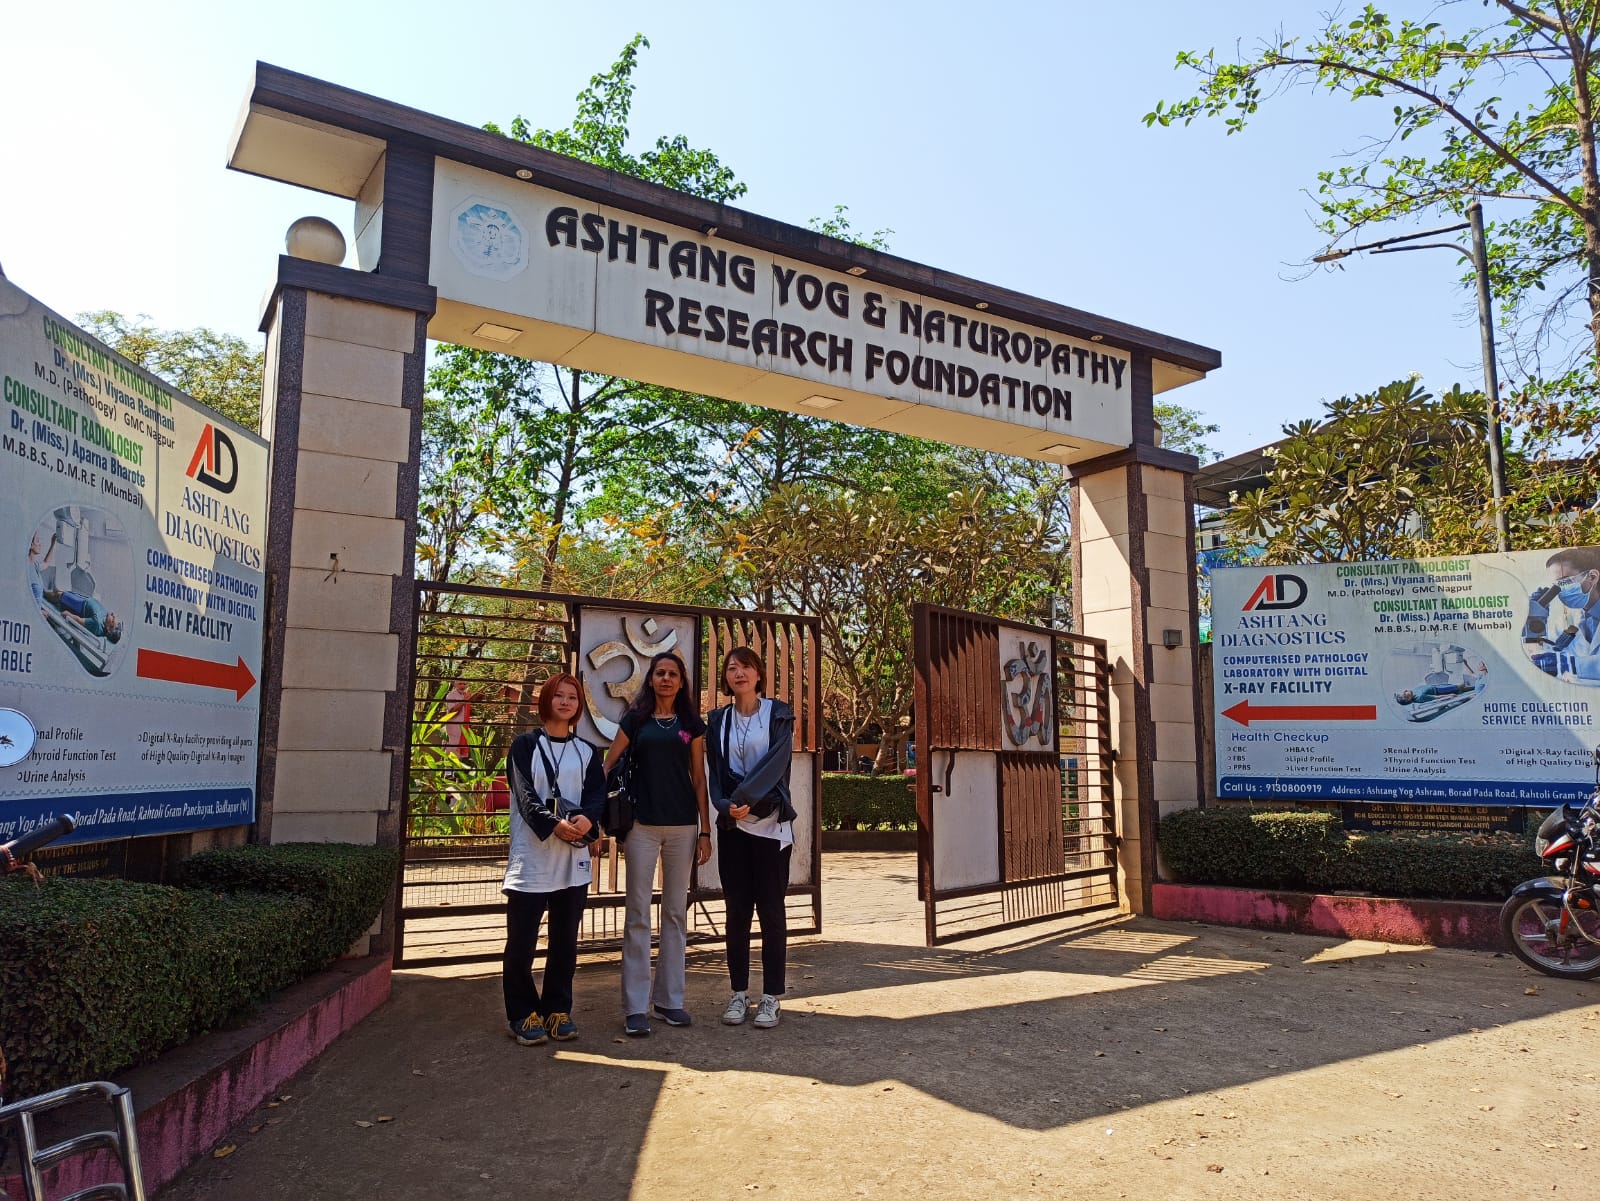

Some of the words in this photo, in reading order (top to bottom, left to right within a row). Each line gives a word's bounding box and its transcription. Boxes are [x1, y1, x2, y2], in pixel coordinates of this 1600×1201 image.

[545, 206, 755, 294] ASHTANG
[771, 264, 850, 319] YOG
[862, 291, 887, 329] &
[900, 301, 1127, 390] NATUROPATHY
[644, 288, 853, 373] RESEARCH
[865, 343, 1072, 421] FOUNDATION
[43, 315, 110, 375] CONSULTANT
[112, 358, 173, 412] PATHOLOGIST
[54, 347, 69, 372] Dr.
[73, 360, 101, 395] (Mrs.)
[104, 378, 135, 411] Viyana
[138, 398, 175, 432] Ramnani
[34, 361, 60, 388] M.D.
[63, 377, 117, 421] (Pathology)
[124, 412, 145, 433] GMC
[147, 425, 175, 449] Nagpur
[4, 375, 79, 435] CONSULTANT
[81, 415, 144, 466] RADIOLOGIST
[11, 409, 28, 435] Dr.
[32, 420, 69, 457] (Miss.)
[72, 439, 108, 471] Aparna
[110, 457, 146, 488] Bharote
[2, 434, 54, 472] M.B.B.S.,
[56, 458, 97, 488] D.M.R.E
[101, 476, 143, 510] (Mumbai)
[181, 486, 250, 535] ASHTANG
[165, 511, 261, 570] DIAGNOSTICS
[146, 548, 213, 585] COMPUTERISED
[215, 571, 258, 600] PATHOLOGY
[1336, 564, 1400, 578] CONSULTANT
[1402, 560, 1471, 574] PATHOLOGIST
[1344, 578, 1358, 587] Dr.
[1361, 577, 1389, 587] (Mrs.)
[1428, 572, 1472, 583] Ramnani
[146, 573, 204, 606] LABORATORY
[205, 592, 226, 613] WITH
[228, 599, 257, 622] DIGITAL
[1327, 590, 1349, 598] M.D.
[1351, 587, 1405, 598] (Pathology)
[1412, 585, 1436, 594] GMC
[1437, 585, 1473, 593] Nagpur
[1373, 599, 1438, 612] CONSULTANT
[1441, 595, 1510, 610] RADIOLOGIST
[144, 600, 183, 631] X-RAY
[185, 612, 233, 642] FACILITY
[1237, 613, 1328, 630] ASHTANG
[1379, 613, 1394, 623] Dr.
[1397, 612, 1430, 623] (Miss.)
[1433, 611, 1469, 623] Aparna
[1472, 609, 1513, 619] Bharote
[1419, 623, 1458, 632] D.M.R.E
[1463, 621, 1512, 631] (Mumbai)
[1220, 630, 1346, 648] DIAGNOSTICS
[1223, 654, 1301, 665] COMPUTERISED
[1304, 652, 1369, 663] PATHOLOGY
[1223, 667, 1290, 678] LABORATORY
[1293, 667, 1321, 677] WITH
[1324, 666, 1369, 676] DIGITAL
[1224, 681, 1265, 694] X-RAY
[1270, 680, 1333, 693] FACILITY
[1484, 702, 1517, 713] HOME
[1521, 702, 1589, 713] COLLECTION
[1481, 715, 1527, 726] SERVICE
[1531, 714, 1593, 725] AVAILABLE
[55, 727, 84, 741] Profile
[142, 731, 166, 747] Digital
[167, 733, 184, 747] X-Ray
[1231, 732, 1270, 742] Health
[1273, 732, 1329, 744] Checkup
[62, 748, 98, 761] Function
[100, 749, 117, 761] Test
[141, 749, 149, 761] of
[150, 750, 166, 765] High
[167, 750, 190, 765] Quality
[190, 751, 211, 765] Digital
[1412, 747, 1439, 755] Profile
[1505, 748, 1534, 757] Digital
[1536, 748, 1562, 758] X-Ray
[1563, 748, 1594, 758] facility
[1289, 755, 1308, 764] Lipid
[1388, 757, 1419, 766] Thyroid
[1516, 758, 1537, 767] High
[1539, 759, 1573, 768] Quality
[1574, 759, 1593, 768] Digi
[23, 769, 49, 783] Urine
[50, 768, 86, 787] Analysis
[1412, 766, 1447, 776] Analysis
[1223, 782, 1243, 792] Call
[1245, 783, 1257, 792] Us
[1265, 783, 1322, 793] 9130800919
[1331, 785, 1361, 795] Address
[1366, 786, 1397, 798] Ashtang
[1398, 786, 1414, 799] Yog
[1414, 787, 1447, 798] Ashram,
[1448, 788, 1472, 798] Borad
[1473, 789, 1493, 798] Pada
[1495, 789, 1518, 799] Road,
[1520, 789, 1551, 800] Rahtoli
[1552, 791, 1576, 800] Gram
[74, 808, 99, 826] Borad
[99, 807, 116, 825] Pada
[164, 803, 182, 818] Gram
